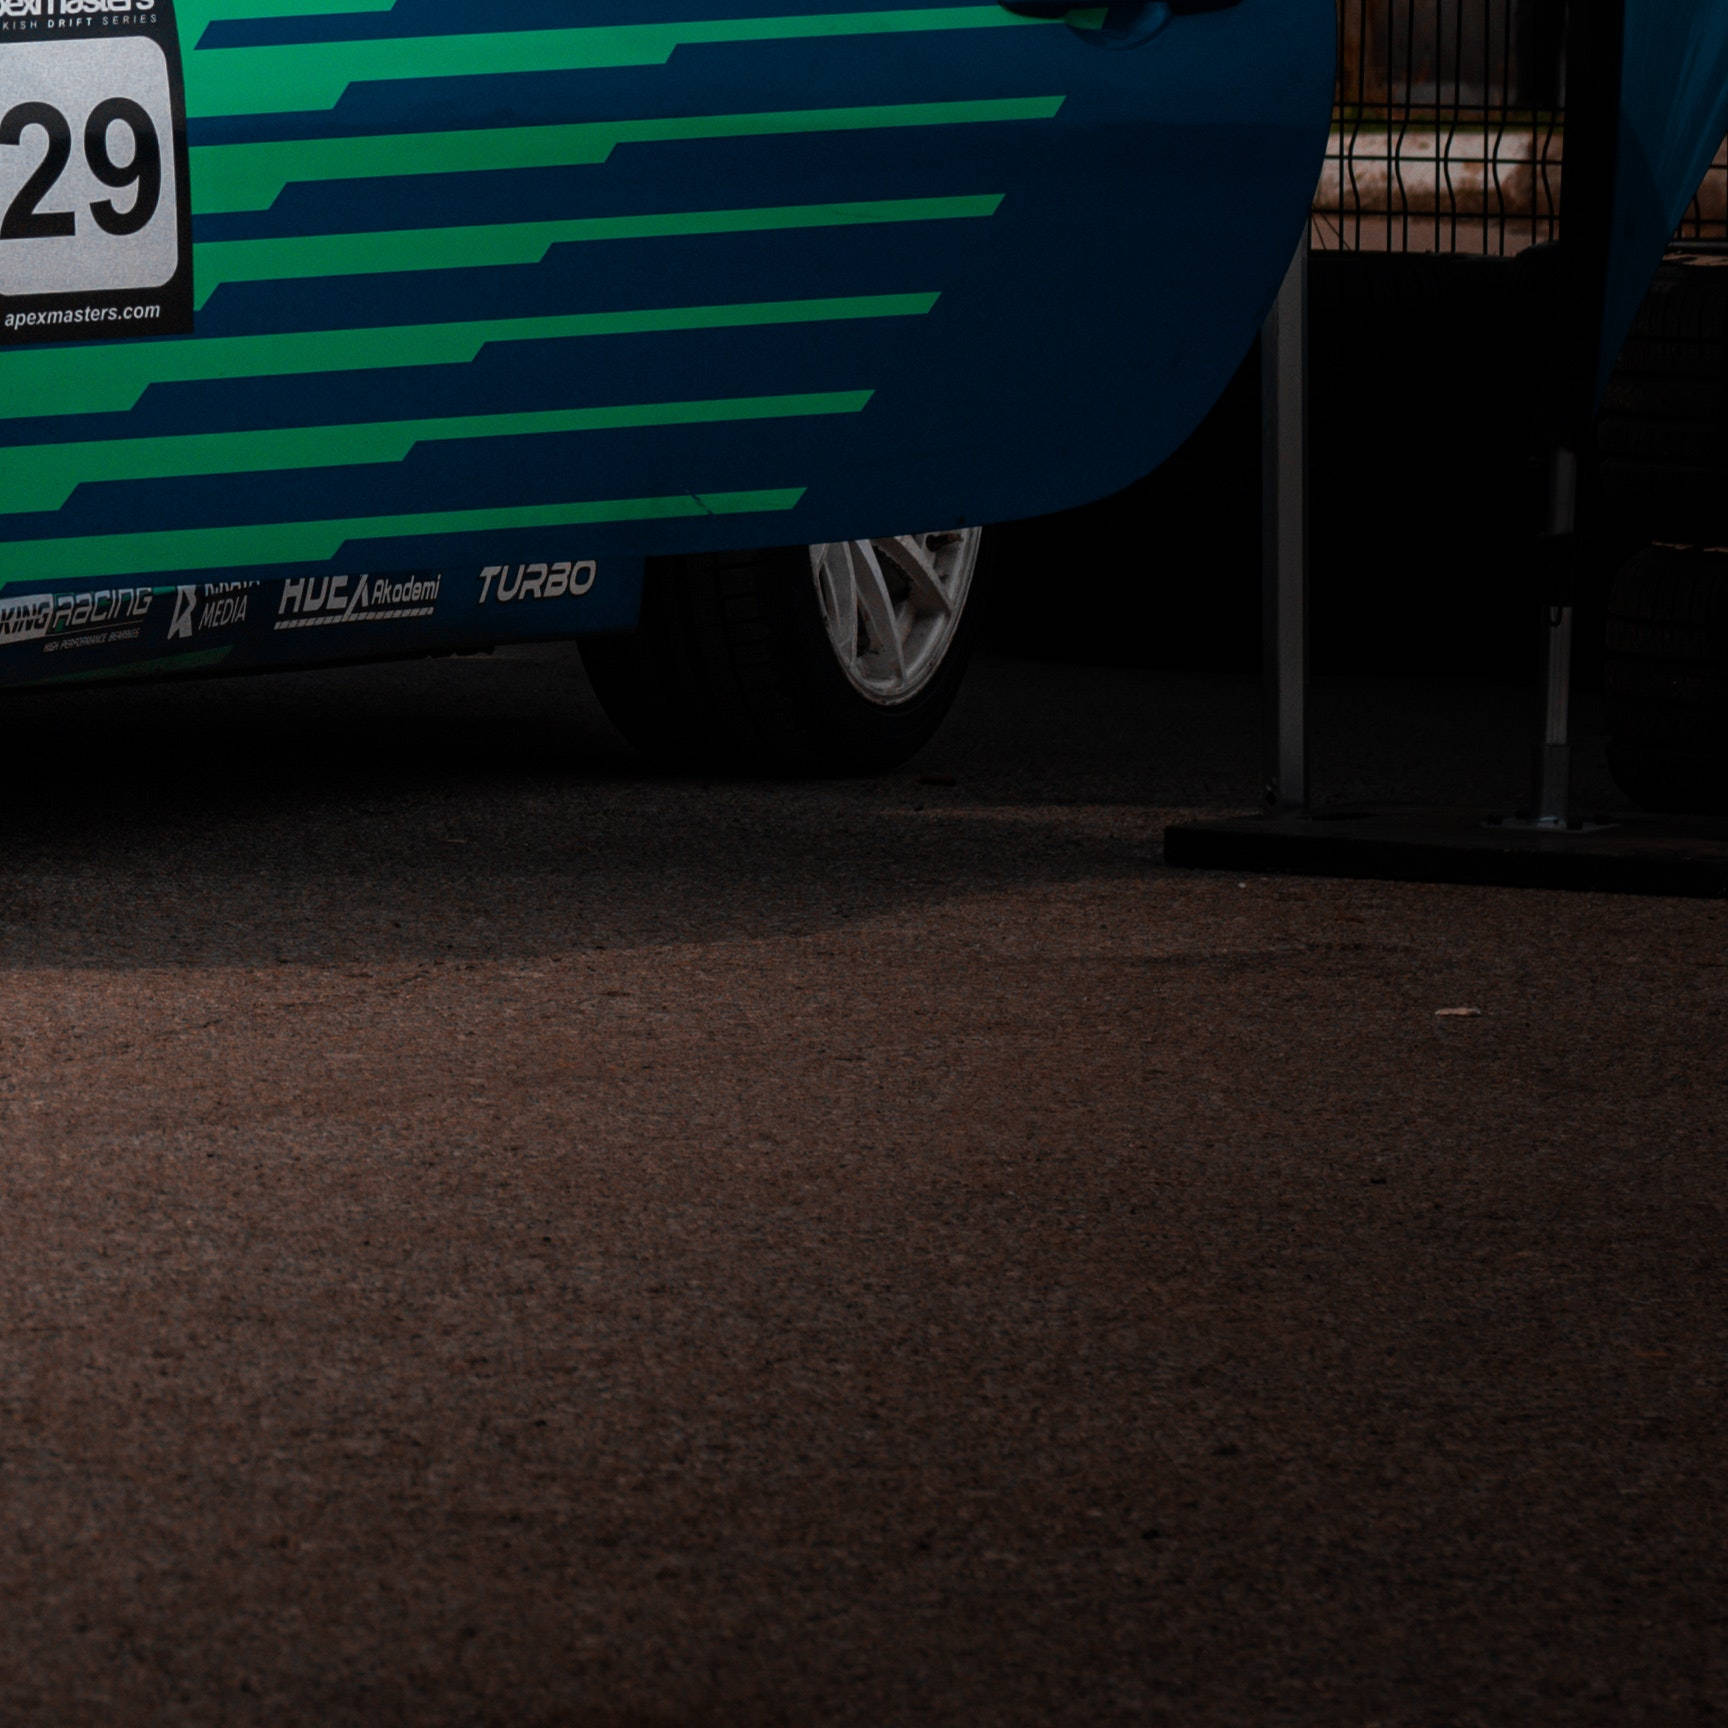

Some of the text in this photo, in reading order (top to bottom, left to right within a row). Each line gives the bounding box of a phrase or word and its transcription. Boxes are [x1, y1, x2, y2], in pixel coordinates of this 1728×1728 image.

[47, 16, 94, 29] DRIFT
[101, 13, 159, 28] SERIES
[4, 303, 161, 329] apexmasters.com
[479, 559, 598, 605] TURBO
[198, 594, 249, 632] MEDIA
